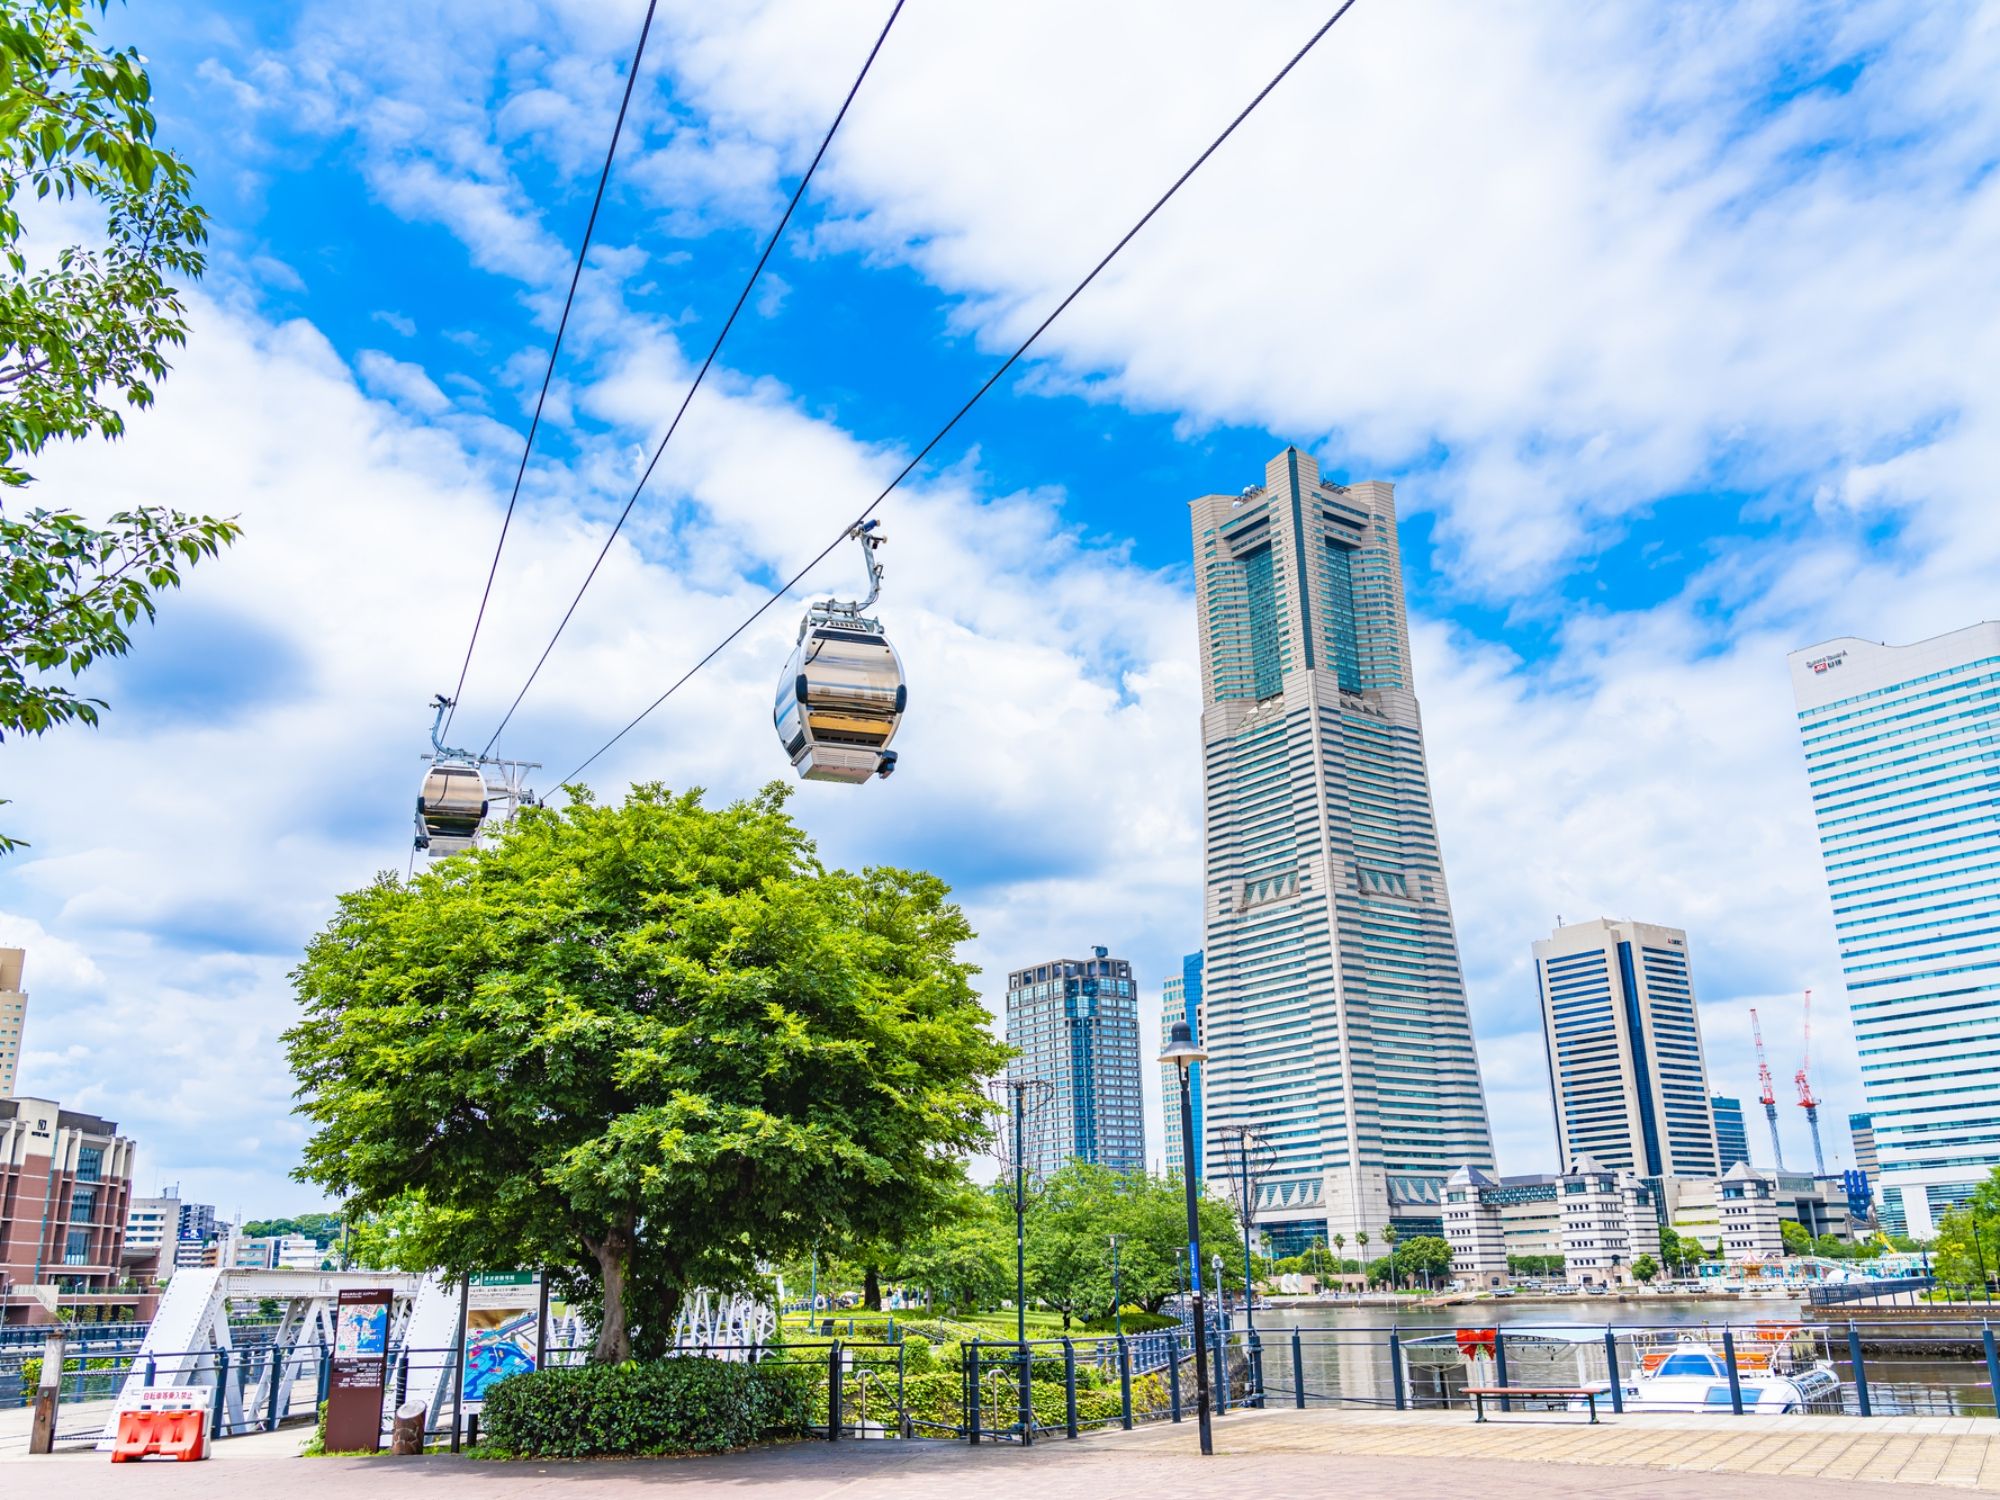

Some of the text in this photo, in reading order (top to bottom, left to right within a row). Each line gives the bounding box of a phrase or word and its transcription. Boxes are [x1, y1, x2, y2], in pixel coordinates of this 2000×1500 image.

[144, 1391, 192, 1400] 自転車等乗入禁止
